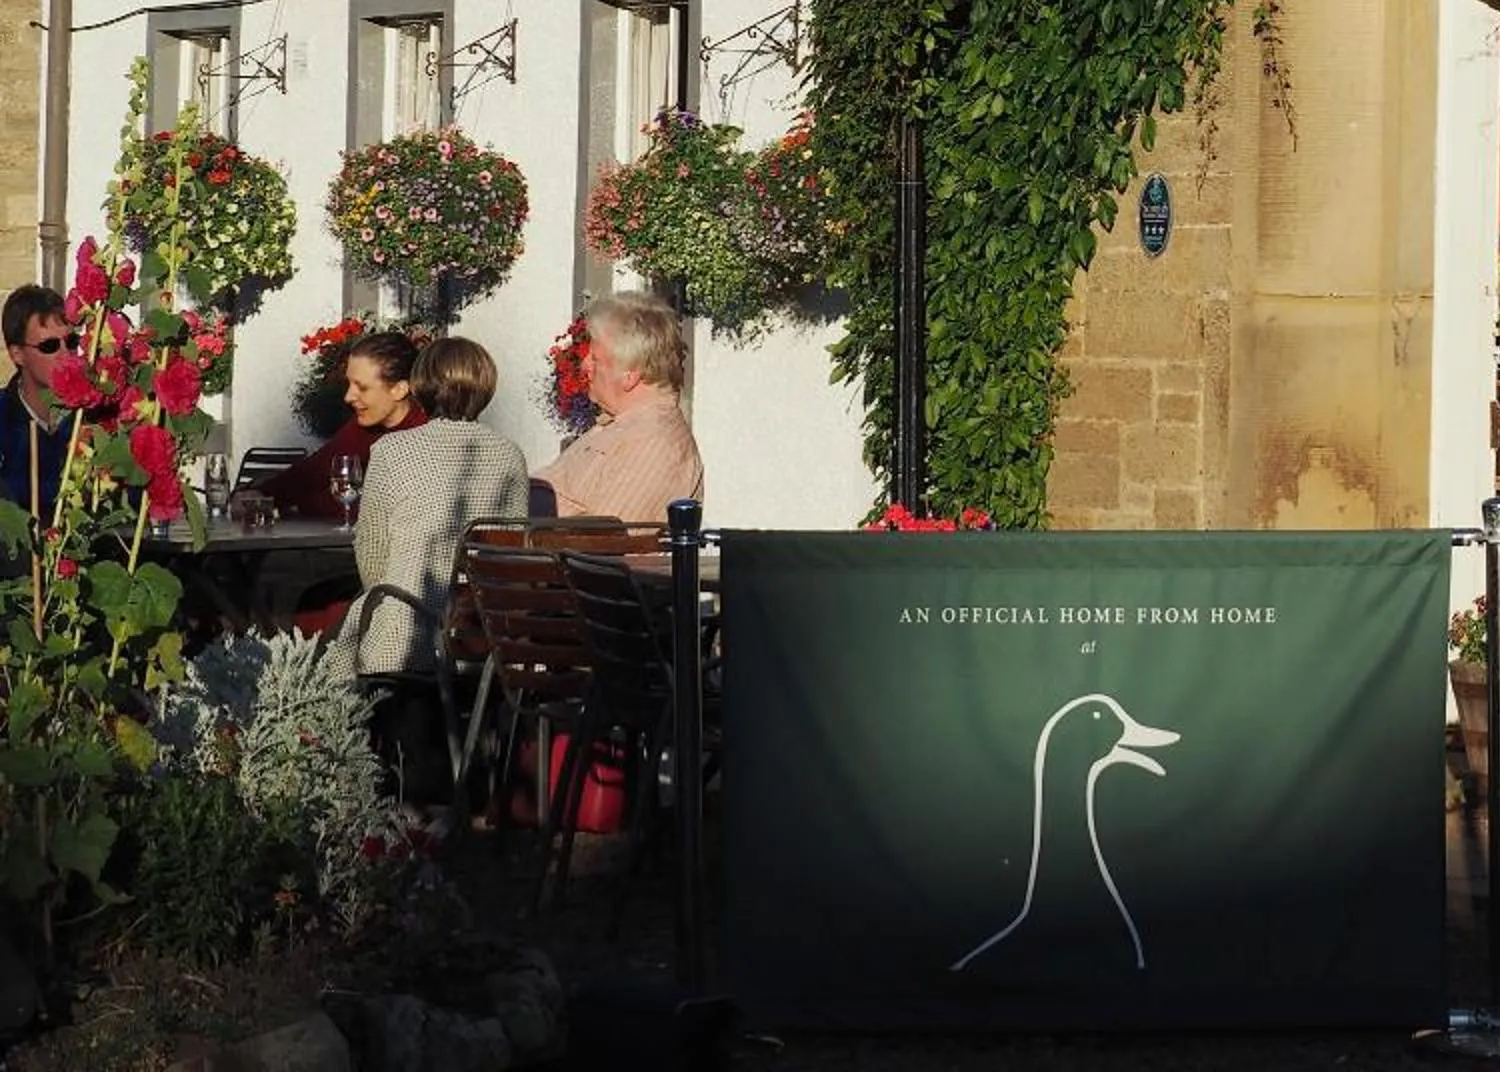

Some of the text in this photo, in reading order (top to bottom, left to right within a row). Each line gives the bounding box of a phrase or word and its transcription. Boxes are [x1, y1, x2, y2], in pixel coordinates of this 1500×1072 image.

[900, 607, 1277, 623] AN OFFICIAL HOME FROM HOME
[1081, 640, 1097, 654] at
